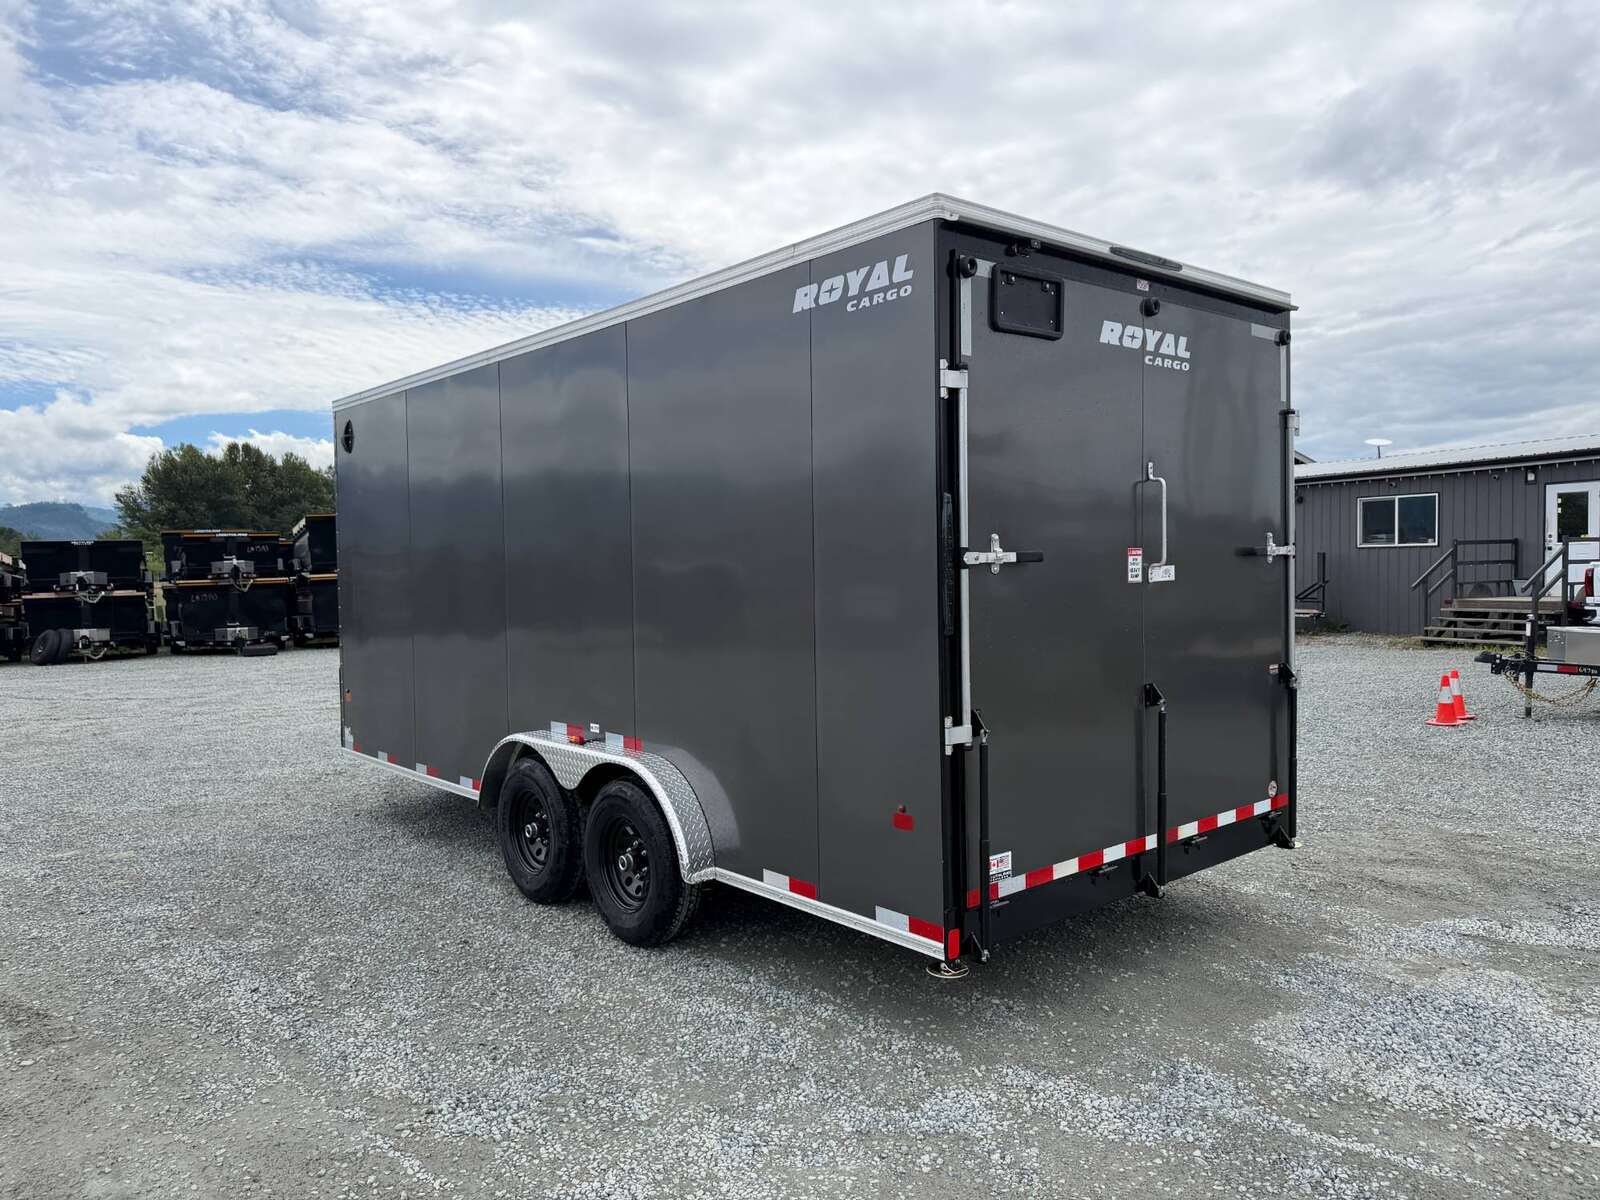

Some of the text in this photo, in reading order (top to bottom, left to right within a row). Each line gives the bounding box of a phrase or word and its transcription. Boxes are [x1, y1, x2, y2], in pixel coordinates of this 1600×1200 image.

[792, 254, 914, 314] ROYAL
[846, 285, 912, 312] CARGO
[1100, 320, 1191, 359] ROYAL
[1144, 355, 1190, 371] CARGO
